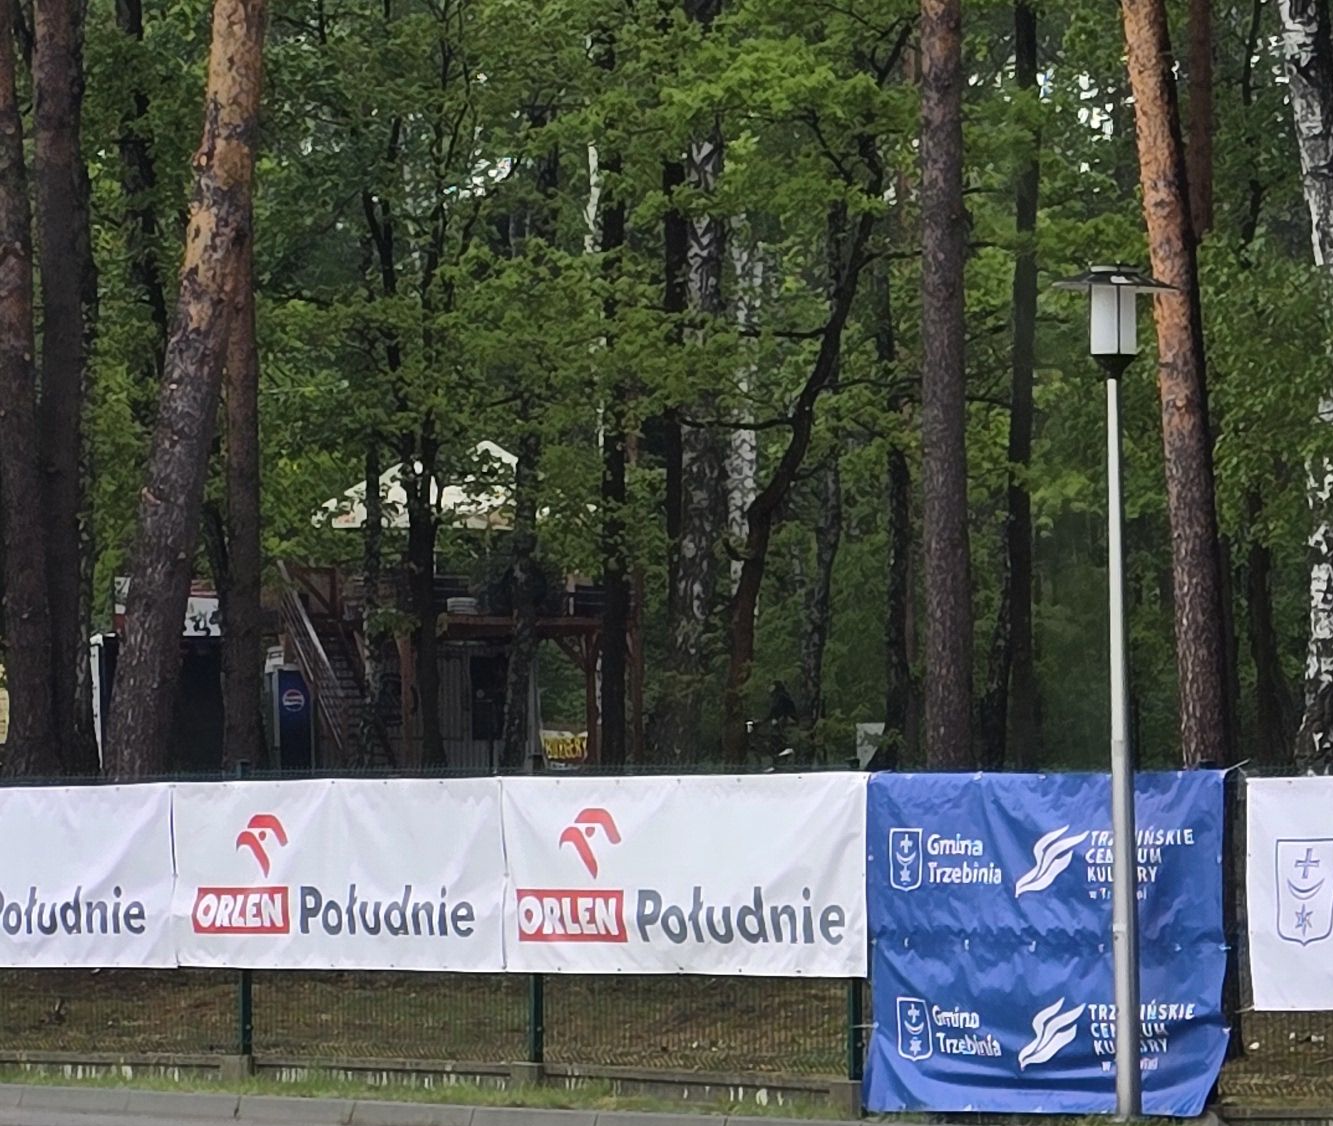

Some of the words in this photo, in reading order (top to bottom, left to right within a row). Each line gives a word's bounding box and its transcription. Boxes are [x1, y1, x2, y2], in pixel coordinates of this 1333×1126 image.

[927, 833, 983, 856] Gmina
[1085, 848, 1162, 864] CENUM
[928, 861, 1002, 885] Trzebinia
[1087, 866, 1158, 882] KULRY
[0, 885, 147, 936] ołudnie
[198, 892, 286, 929] ORLEN
[300, 884, 476, 937] Południe
[519, 895, 620, 937] ORLEN
[637, 887, 846, 945] Południe
[932, 1005, 980, 1029] Gmina
[1088, 999, 1195, 1020] TRZIŃSKIE
[936, 1032, 1002, 1057] Trzebinia
